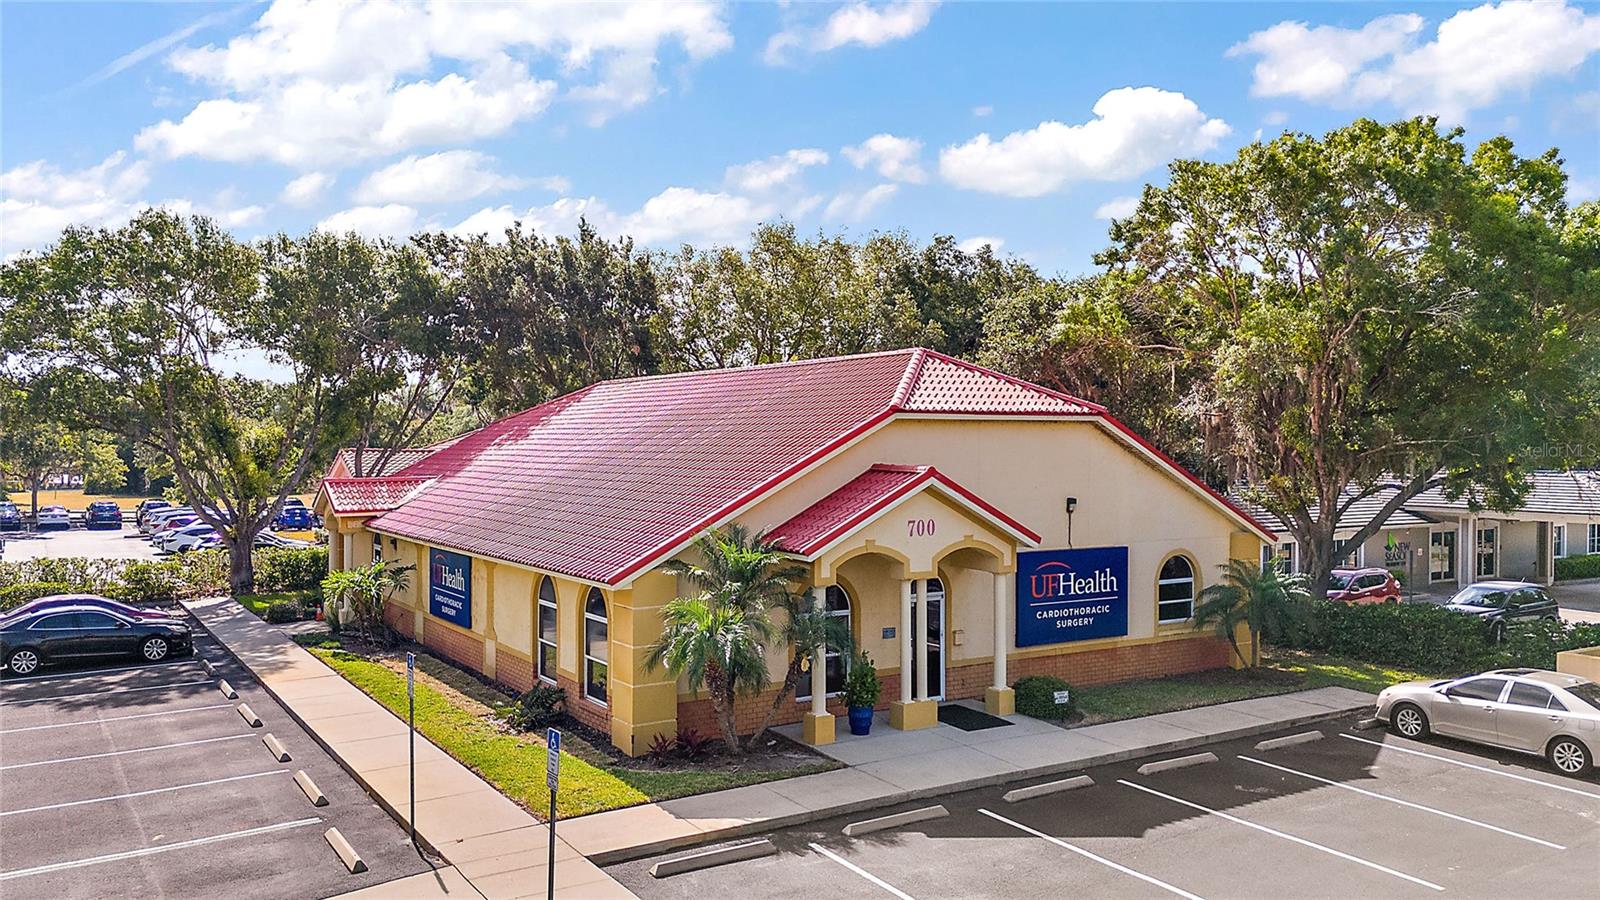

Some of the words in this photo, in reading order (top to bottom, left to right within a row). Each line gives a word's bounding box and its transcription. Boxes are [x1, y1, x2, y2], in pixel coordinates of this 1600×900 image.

[907, 518, 935, 537] 700
[1385, 552, 1406, 561] SEASO
[1036, 605, 1110, 619] CARDIOTHORACIC
[1056, 617, 1094, 629] SURGERY
